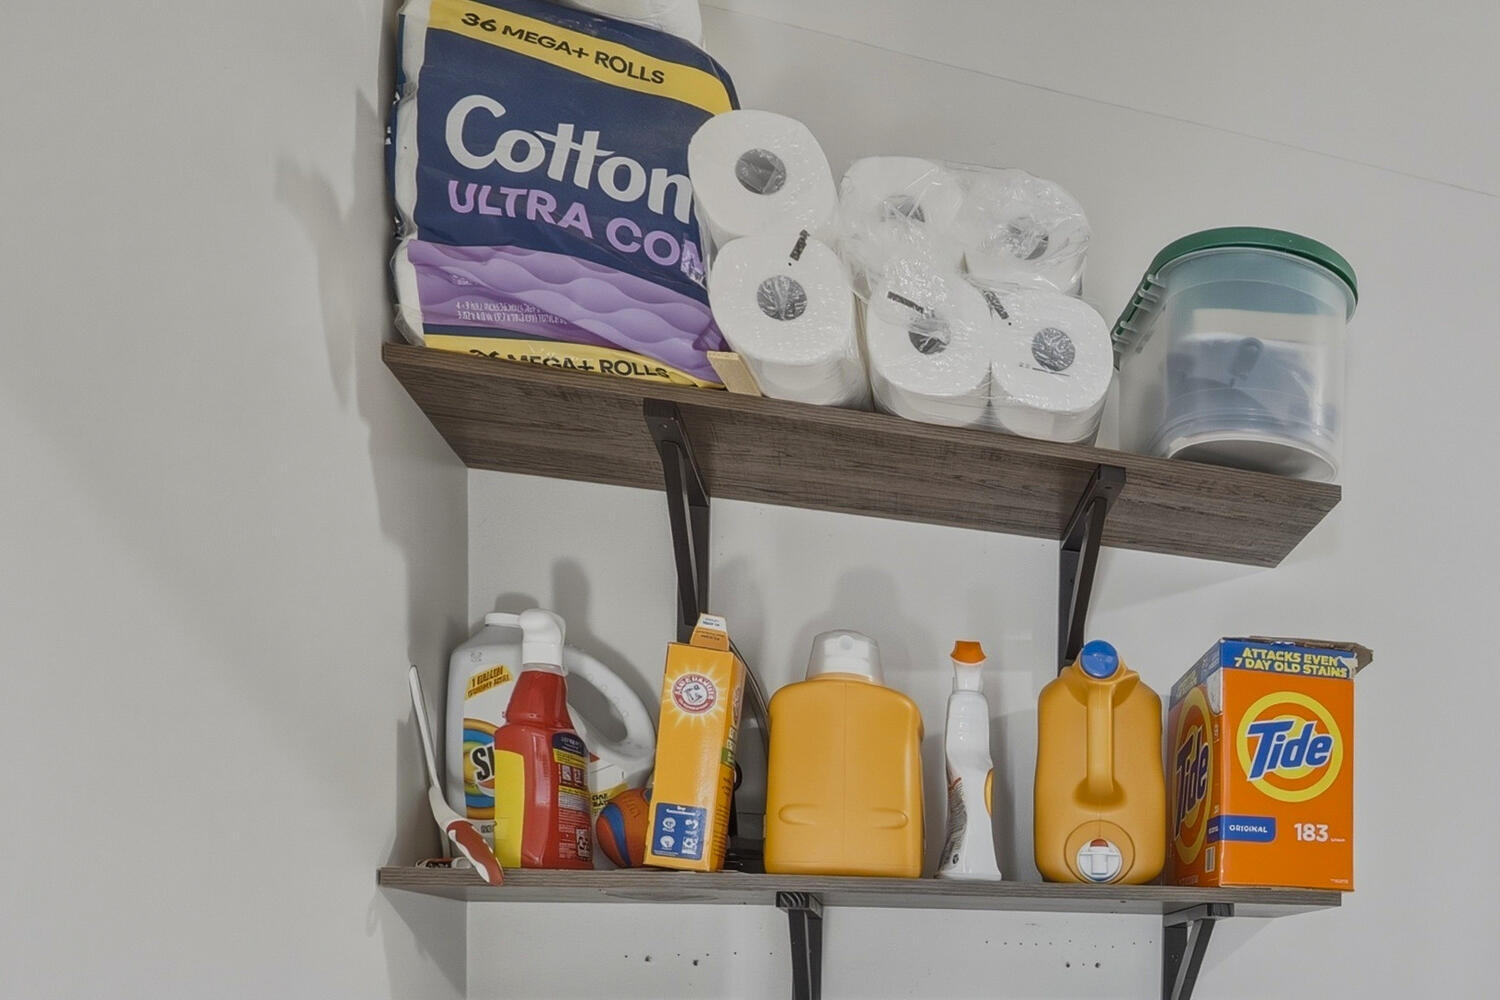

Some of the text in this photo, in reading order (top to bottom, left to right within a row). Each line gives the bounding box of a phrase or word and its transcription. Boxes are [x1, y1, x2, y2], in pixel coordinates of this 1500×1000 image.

[461, 13, 665, 84] 36 MEGA+ ROLLS
[448, 180, 594, 239] ULTRA
[599, 359, 671, 378] ROLLS
[1242, 647, 1338, 666] ATTACKS EVEN
[1234, 657, 1348, 678] 7 DAY OLD STAINS
[1246, 719, 1334, 782] Tide
[1174, 724, 1209, 840] Tide
[1229, 823, 1268, 833] ORIGINAL
[1294, 823, 1329, 842] 183
